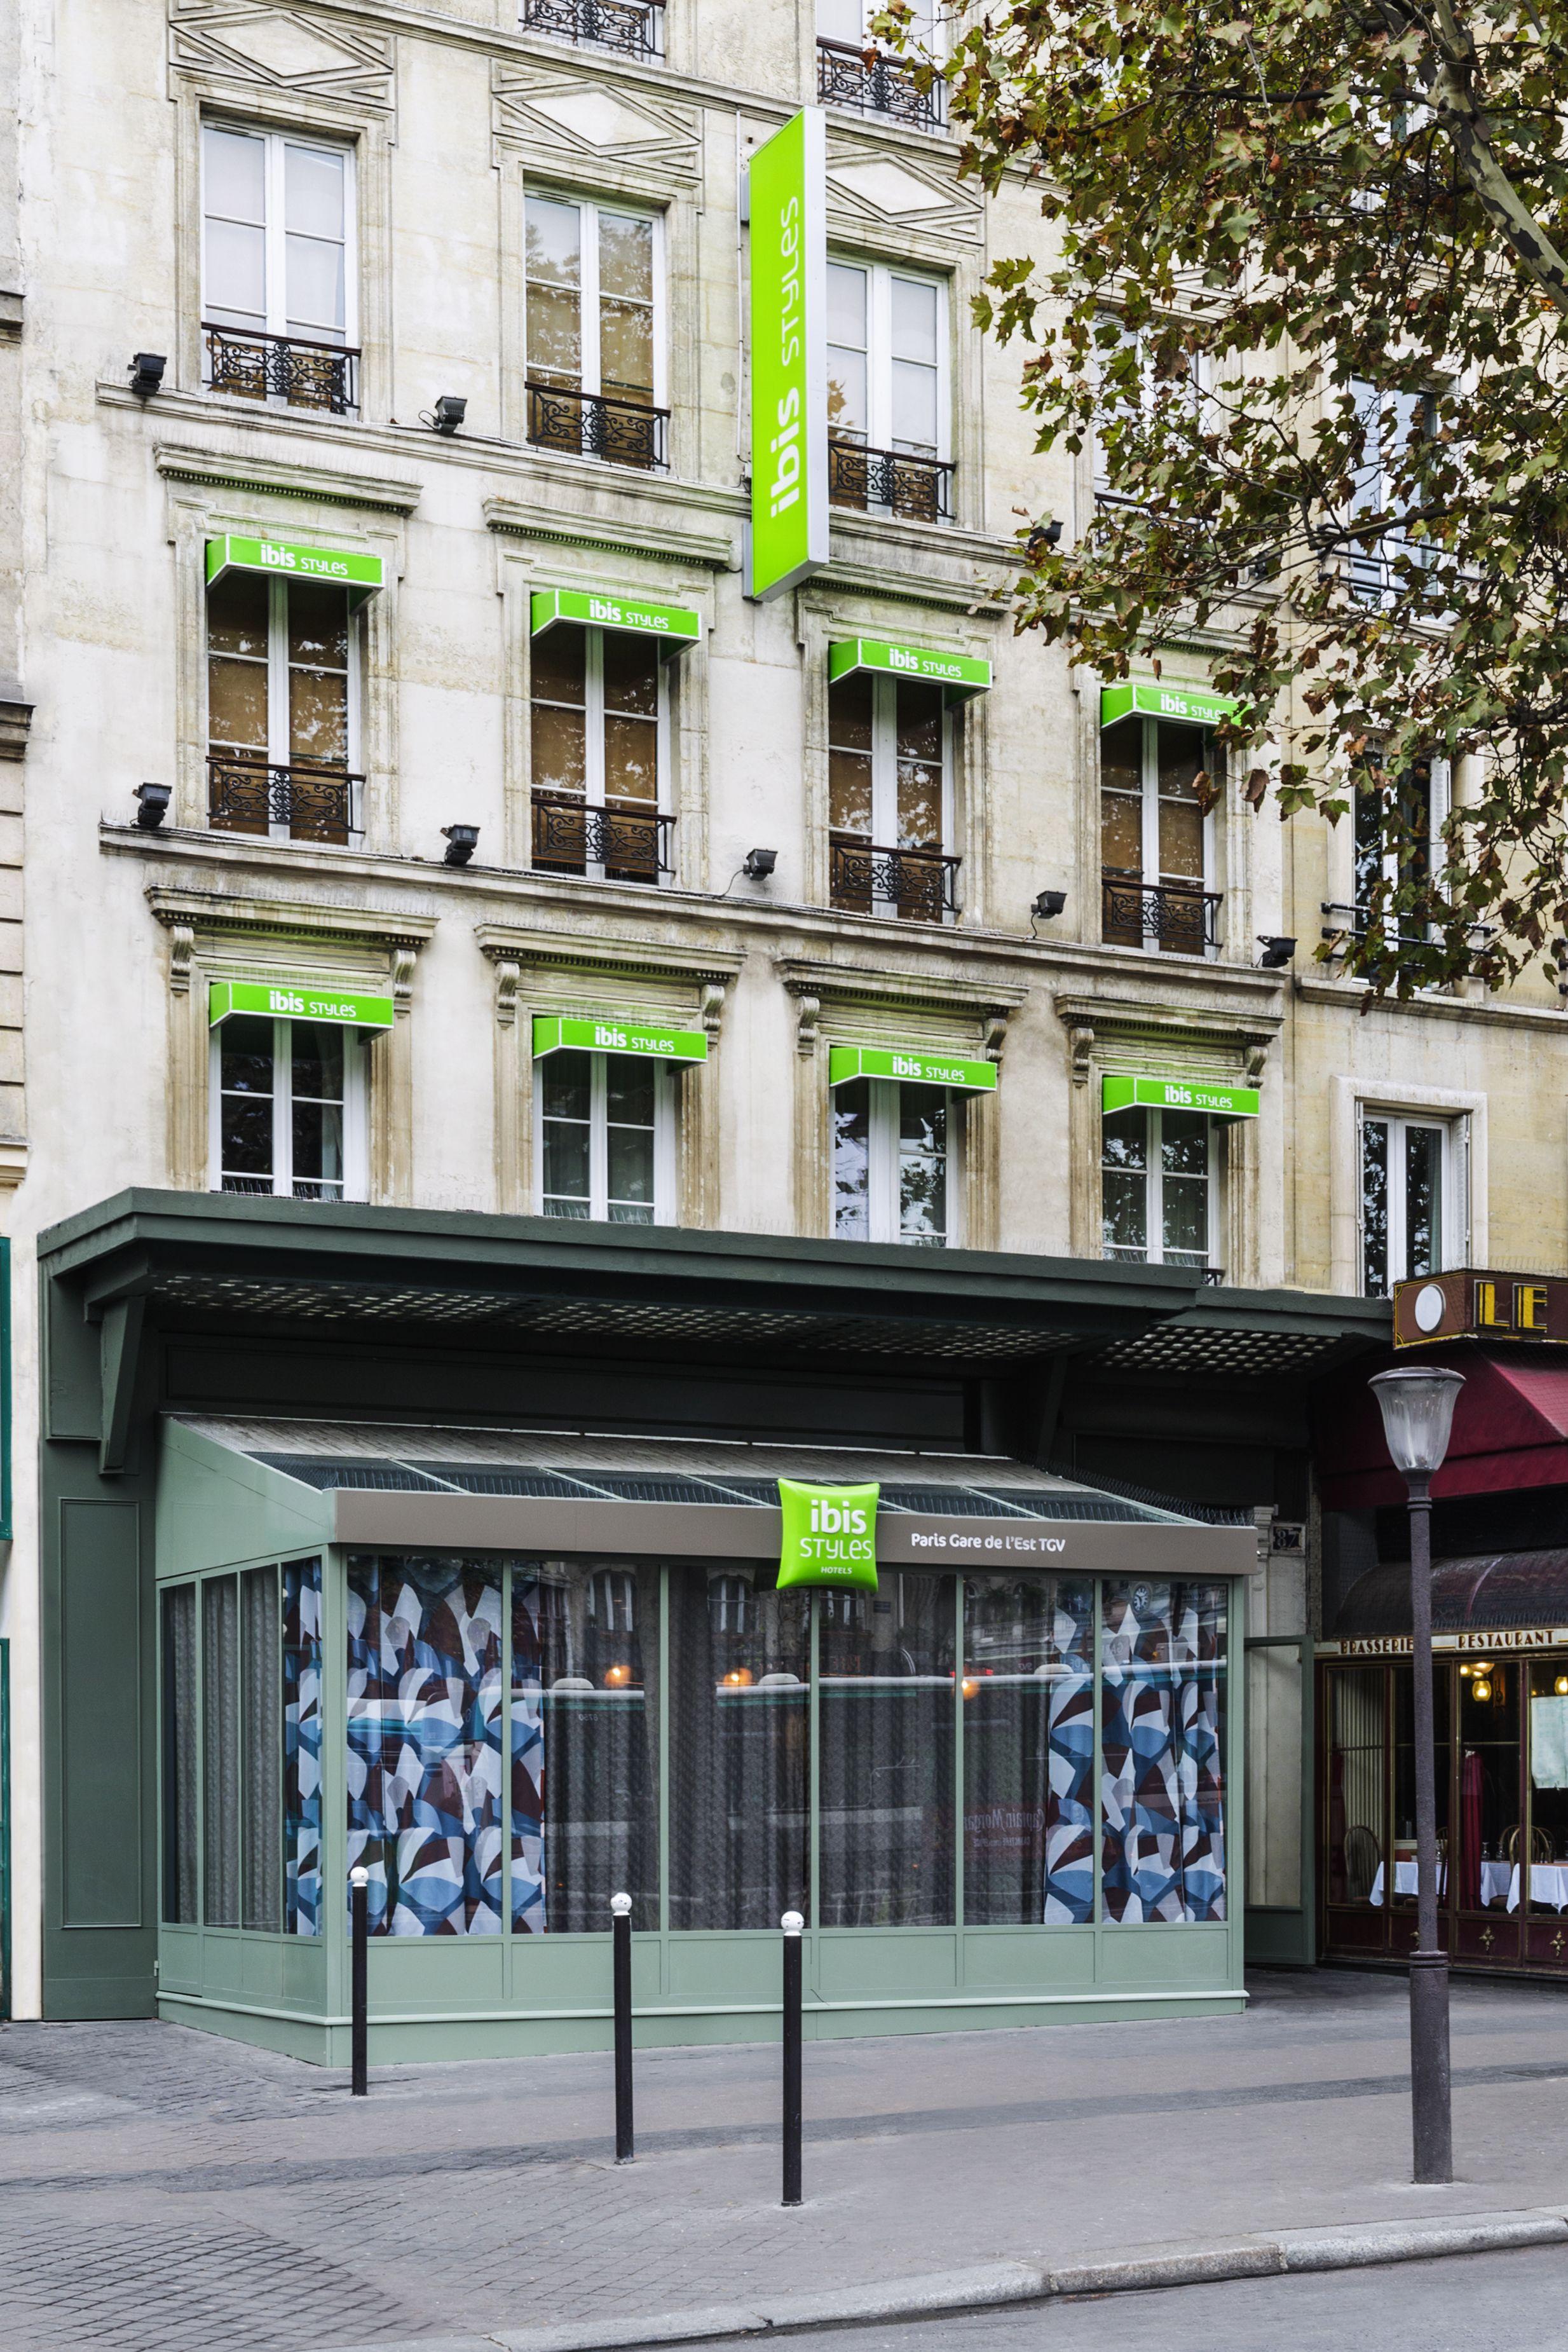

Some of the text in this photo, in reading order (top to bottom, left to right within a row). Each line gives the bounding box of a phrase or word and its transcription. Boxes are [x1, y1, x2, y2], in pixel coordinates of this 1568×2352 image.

[770, 387, 800, 517] ibis
[261, 544, 296, 568] ibis
[589, 599, 622, 622] ibis
[889, 648, 918, 670] ibis
[1160, 693, 1227, 721] ibis STYLE
[269, 990, 304, 1013] ibis
[595, 1026, 627, 1047] ibis
[892, 1056, 922, 1076] ibis
[1165, 1085, 1192, 1104] ibis
[1473, 1279, 1548, 1333] LE
[810, 1499, 866, 1535] ibis
[911, 1533, 946, 1547] Paris
[949, 1533, 982, 1549] Gare
[985, 1535, 1002, 1549] de
[1039, 1538, 1066, 1552] TGV
[1278, 1530, 1298, 1547] 87
[820, 1566, 852, 1575] HOTELS
[1458, 1630, 1555, 1649] RESTAURANT
